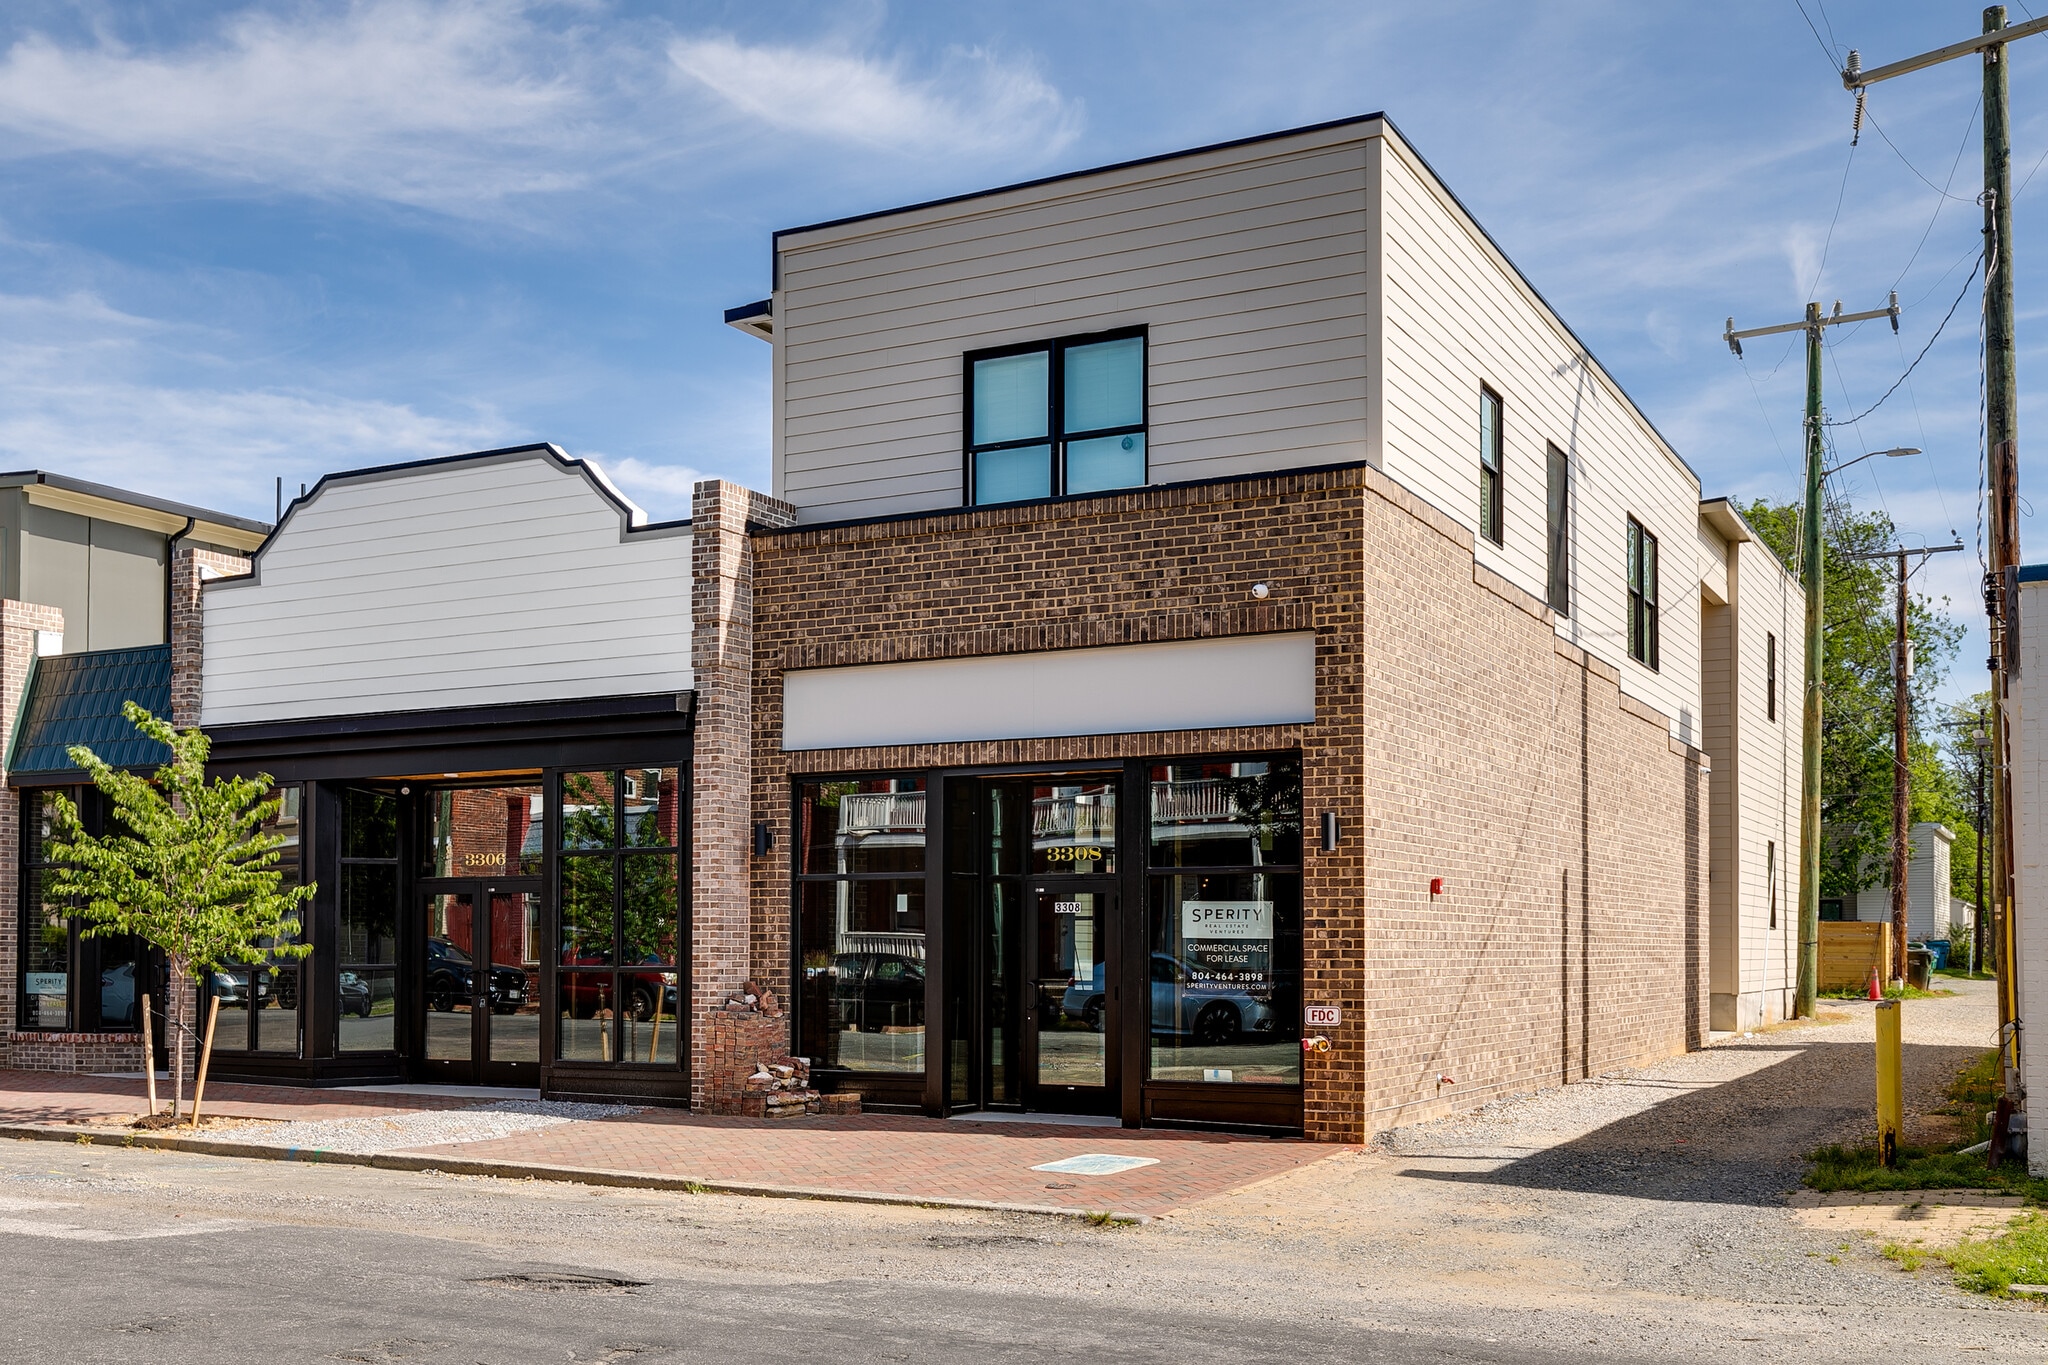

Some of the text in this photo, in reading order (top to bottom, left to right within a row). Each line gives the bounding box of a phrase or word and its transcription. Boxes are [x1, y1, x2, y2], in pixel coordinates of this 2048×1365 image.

[1047, 846, 1102, 861] 3308
[465, 853, 506, 866] 3306
[1056, 903, 1081, 912] 3308
[1192, 908, 1262, 922] SPERITY
[1187, 944, 1269, 953] COMMERCIAL SPACE
[1224, 955, 1249, 963] LEASE
[1191, 971, 1264, 981] 804-464-3898
[1186, 982, 1267, 990] SPERITYVENTURES.COM
[1311, 1010, 1335, 1022] FDC
